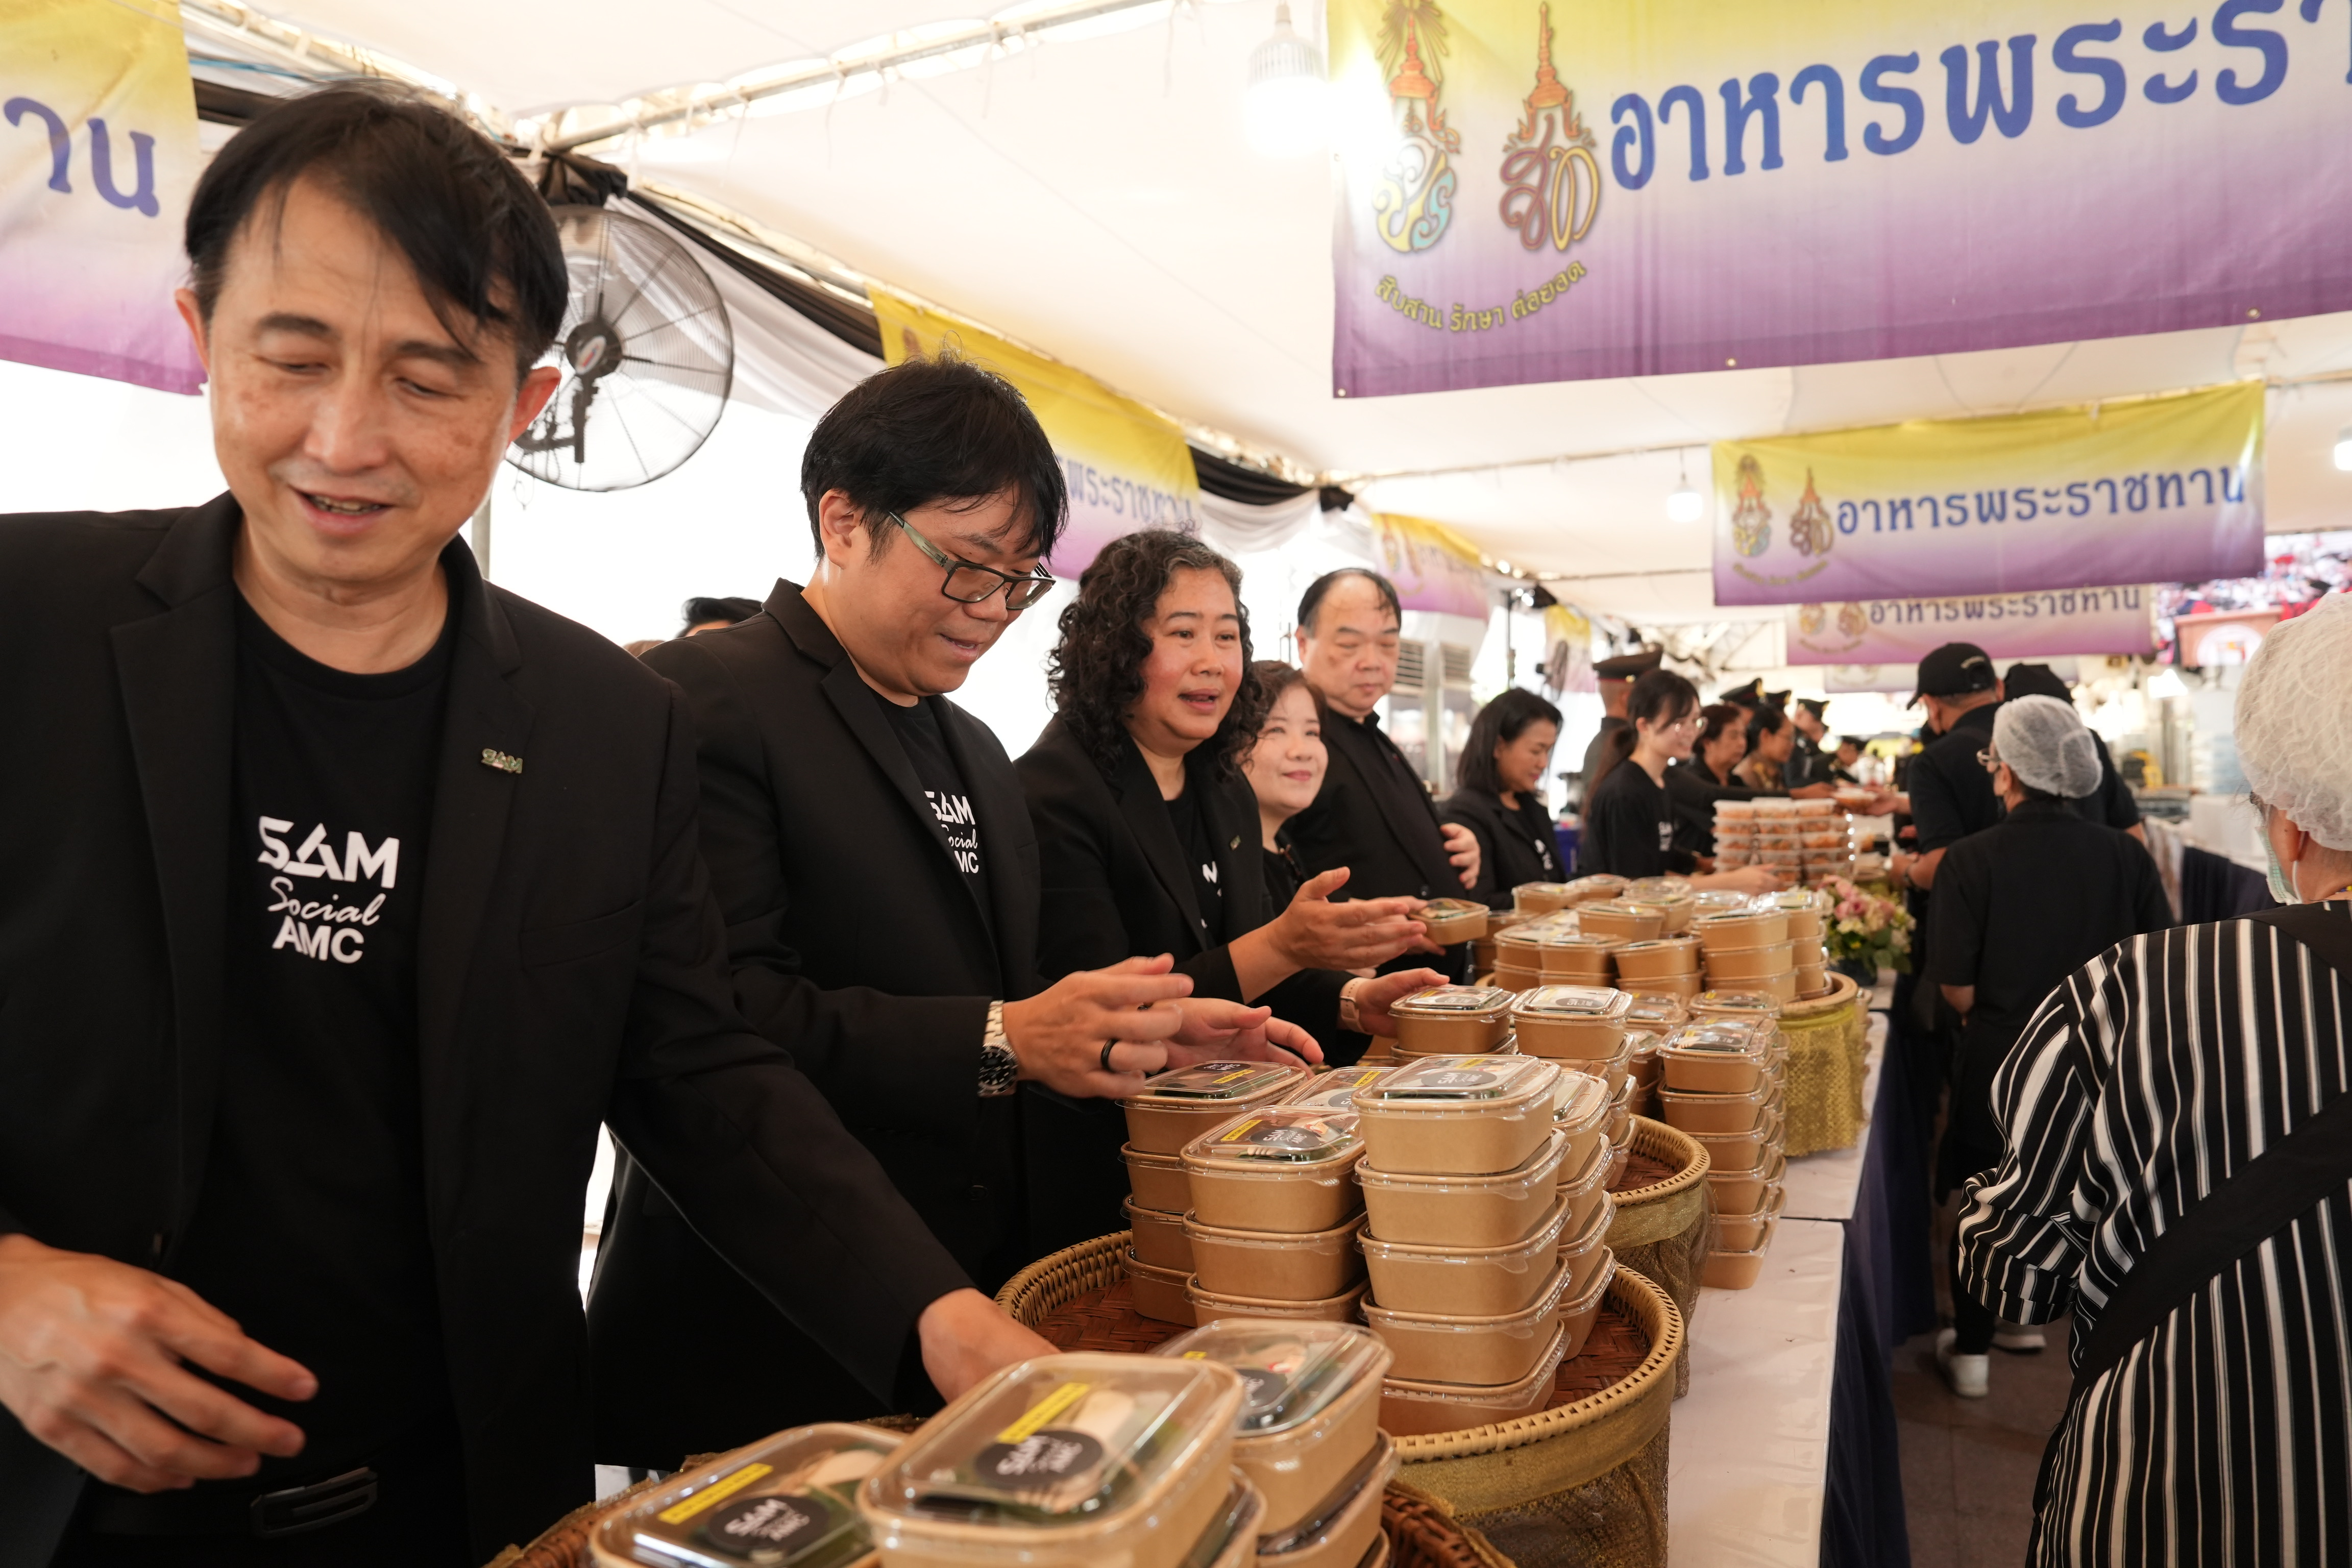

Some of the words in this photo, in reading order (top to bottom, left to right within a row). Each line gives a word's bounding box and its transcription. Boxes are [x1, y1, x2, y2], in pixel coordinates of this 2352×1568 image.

[1375, 275, 1443, 330] สืบสาน
[1449, 302, 1505, 332] รักษา
[1511, 260, 1587, 320] ต่อยอด
[1837, 464, 2246, 536] อาหารพระราชทาน
[257, 816, 400, 889] SAM
[267, 876, 387, 926] Social
[272, 915, 365, 964] AMC
[1263, 1129, 1289, 1142] SAM
[1290, 1133, 1308, 1144] AMC
